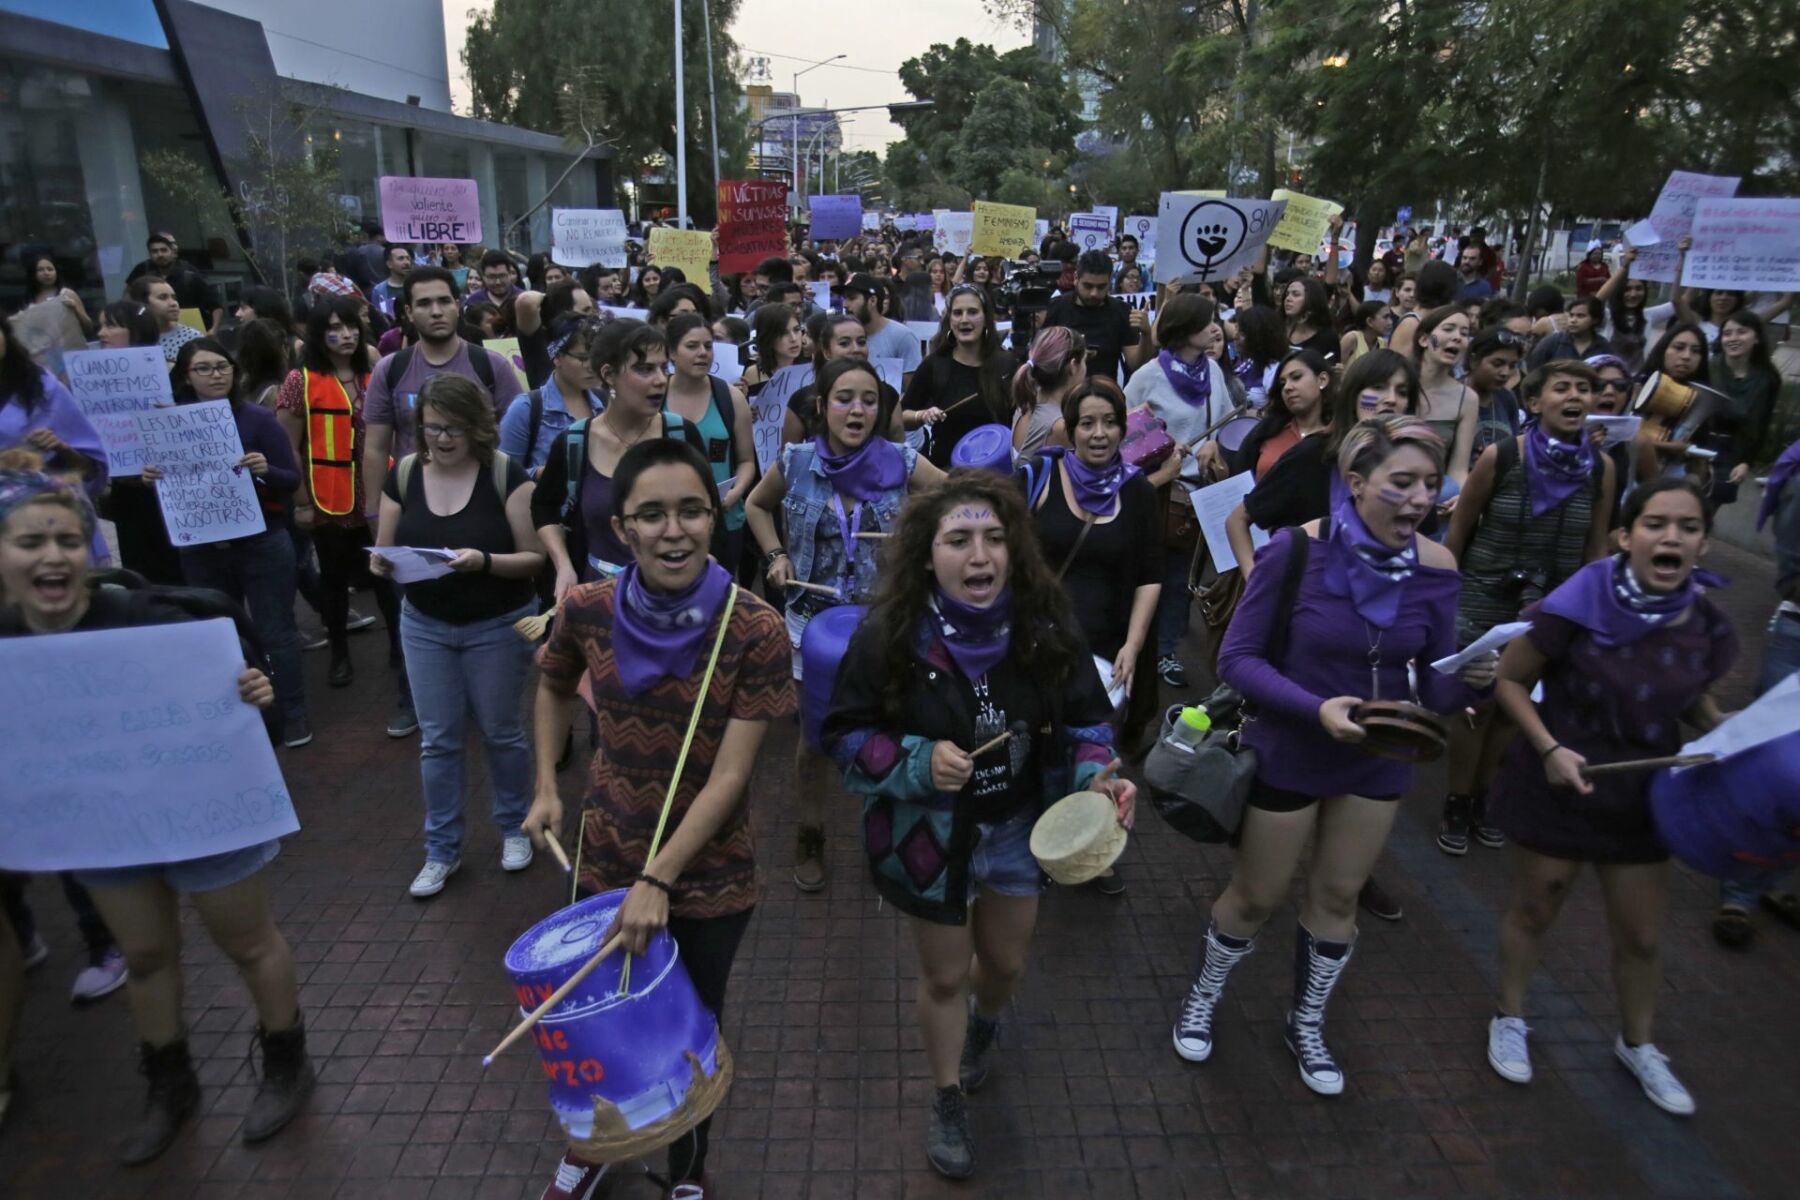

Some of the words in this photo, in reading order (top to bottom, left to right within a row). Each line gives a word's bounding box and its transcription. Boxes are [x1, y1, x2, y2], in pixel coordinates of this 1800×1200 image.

[720, 185, 731, 202] NI
[720, 207, 732, 224] NI
[72, 355, 131, 376] CUANDO
[73, 374, 161, 396] ROMPEMOS
[761, 371, 791, 398] MI
[137, 416, 165, 432] LES
[167, 414, 188, 429] DA
[189, 406, 233, 425] MIEDO
[143, 433, 160, 446] EL
[165, 422, 237, 444] FEMINISMO
[192, 440, 237, 459] CREEN
[183, 457, 231, 474] VAMOS
[160, 478, 169, 488] A
[170, 473, 208, 487] HACER
[210, 472, 229, 485] LO
[162, 488, 206, 501] MISMO
[211, 485, 241, 500] QUE
[223, 499, 250, 509] CON
[174, 504, 257, 529] NOSOTRAS
[196, 697, 235, 721] DE
